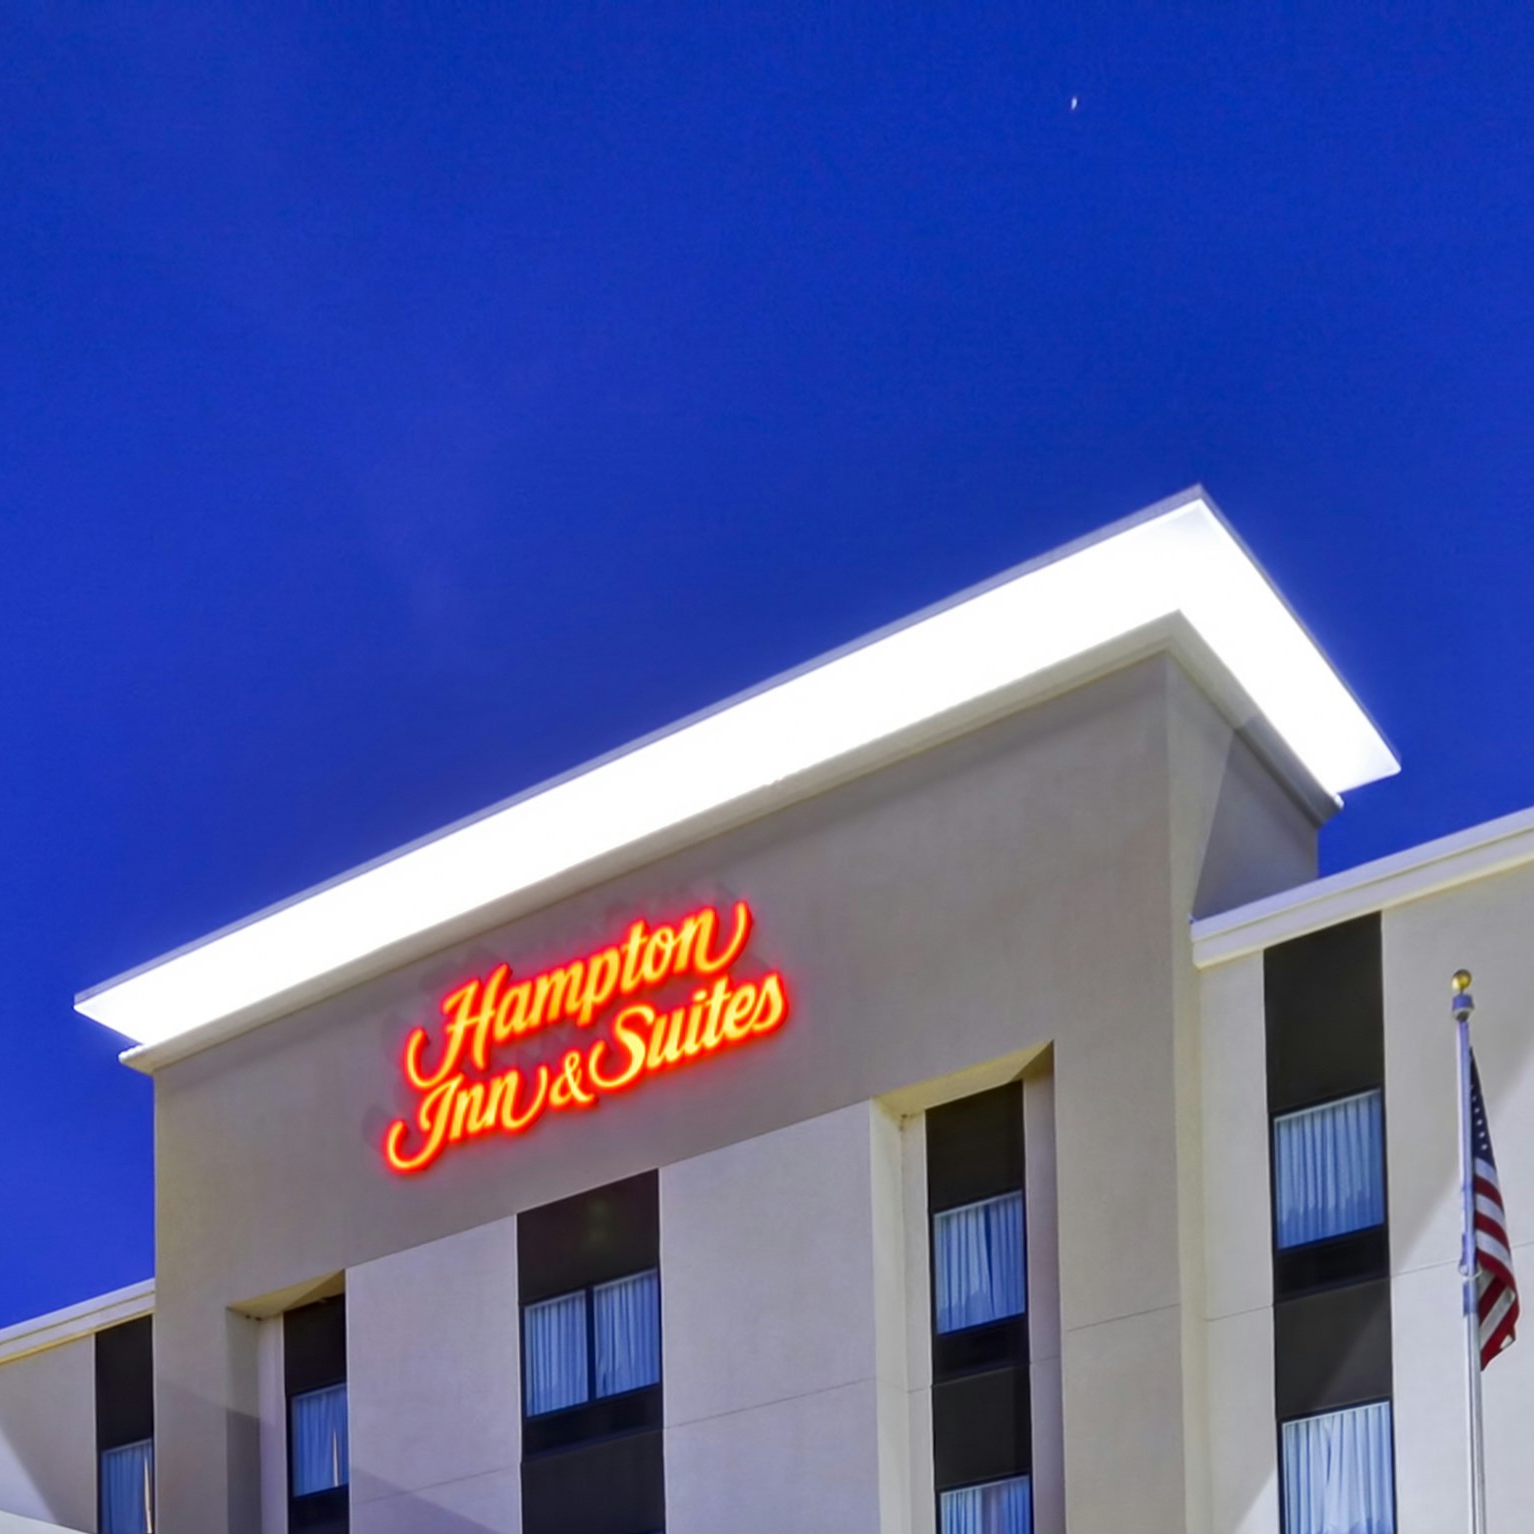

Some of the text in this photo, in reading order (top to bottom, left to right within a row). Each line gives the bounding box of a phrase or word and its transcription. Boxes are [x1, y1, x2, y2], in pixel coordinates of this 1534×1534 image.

[384, 970, 787, 1172] Inn & Suites
[403, 899, 754, 1091] Hampton
